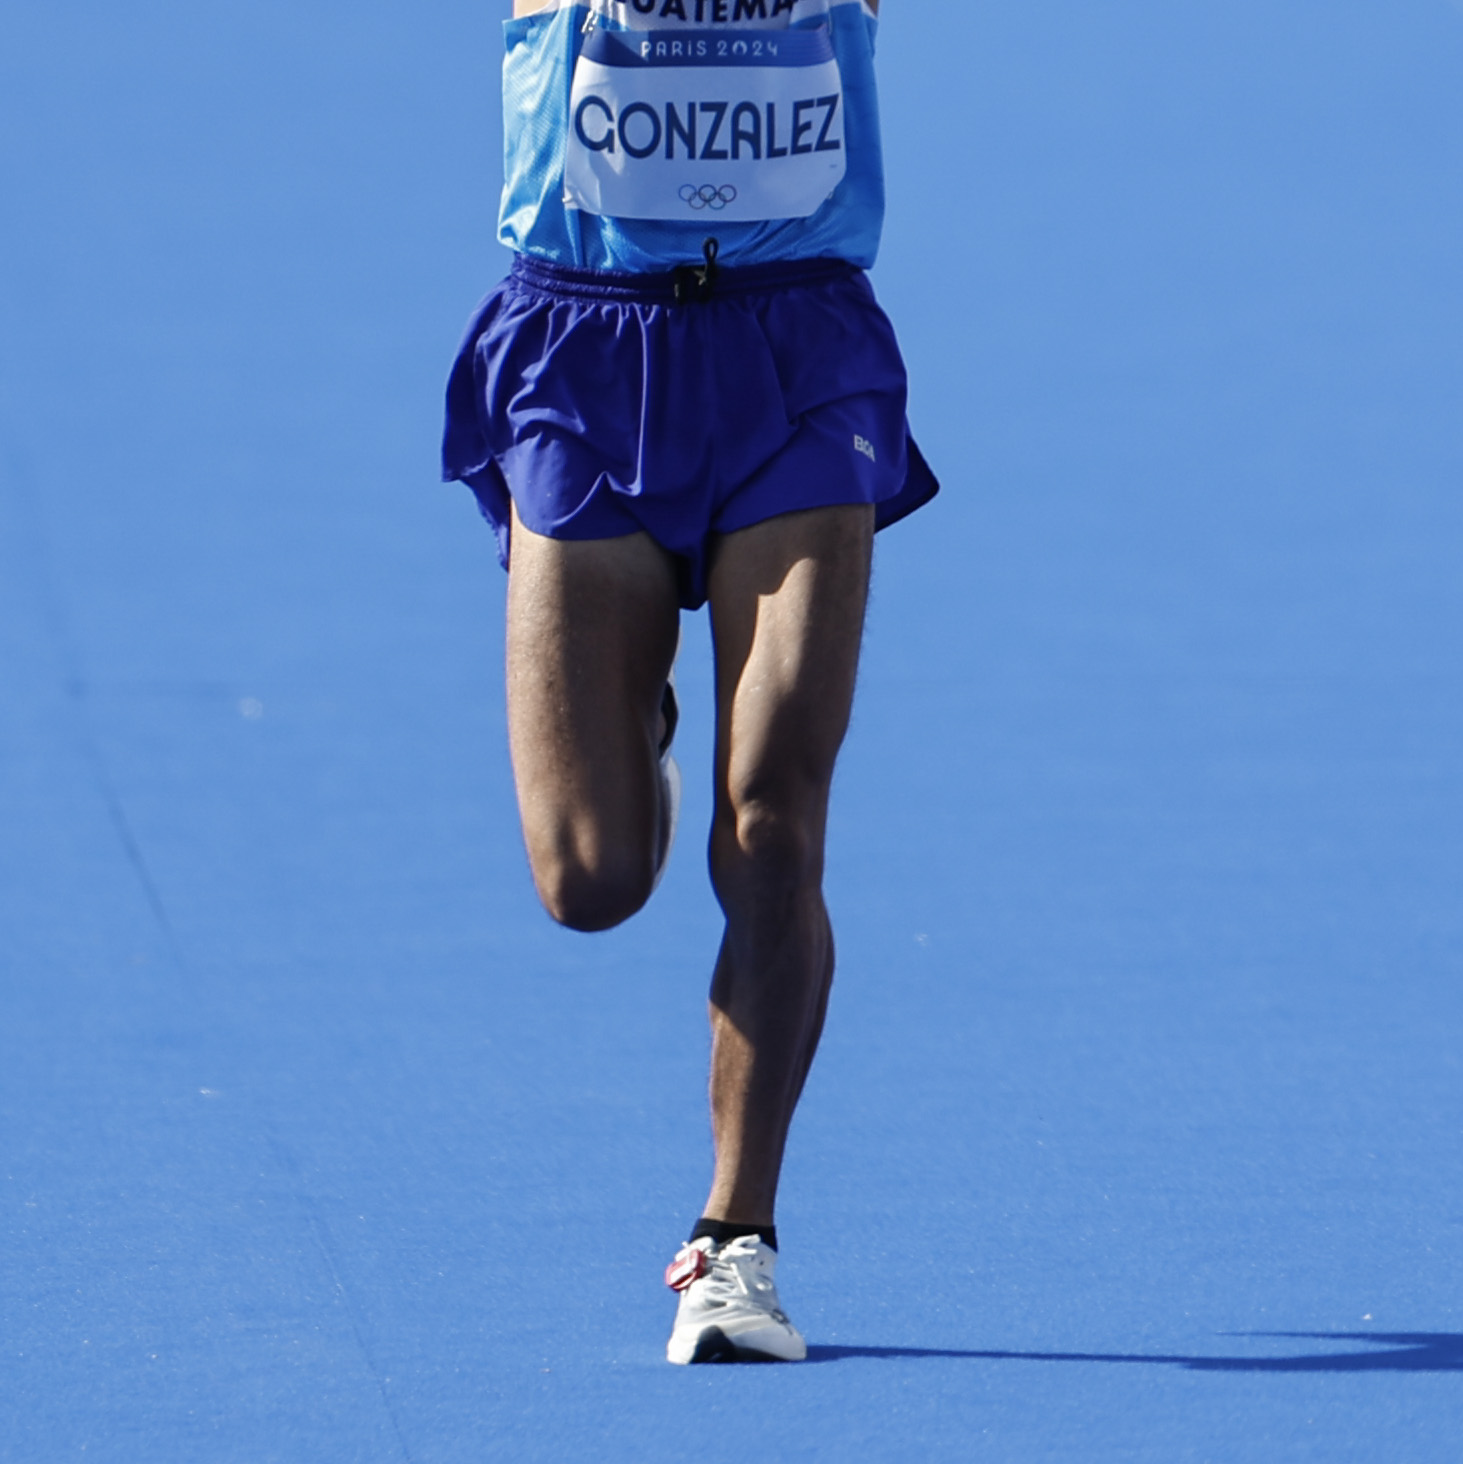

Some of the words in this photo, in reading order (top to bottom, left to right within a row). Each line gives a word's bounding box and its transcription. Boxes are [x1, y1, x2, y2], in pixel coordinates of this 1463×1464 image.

[640, 39, 708, 58] PARIS
[716, 39, 779, 57] 2024
[574, 93, 841, 160] GONZALEZ
